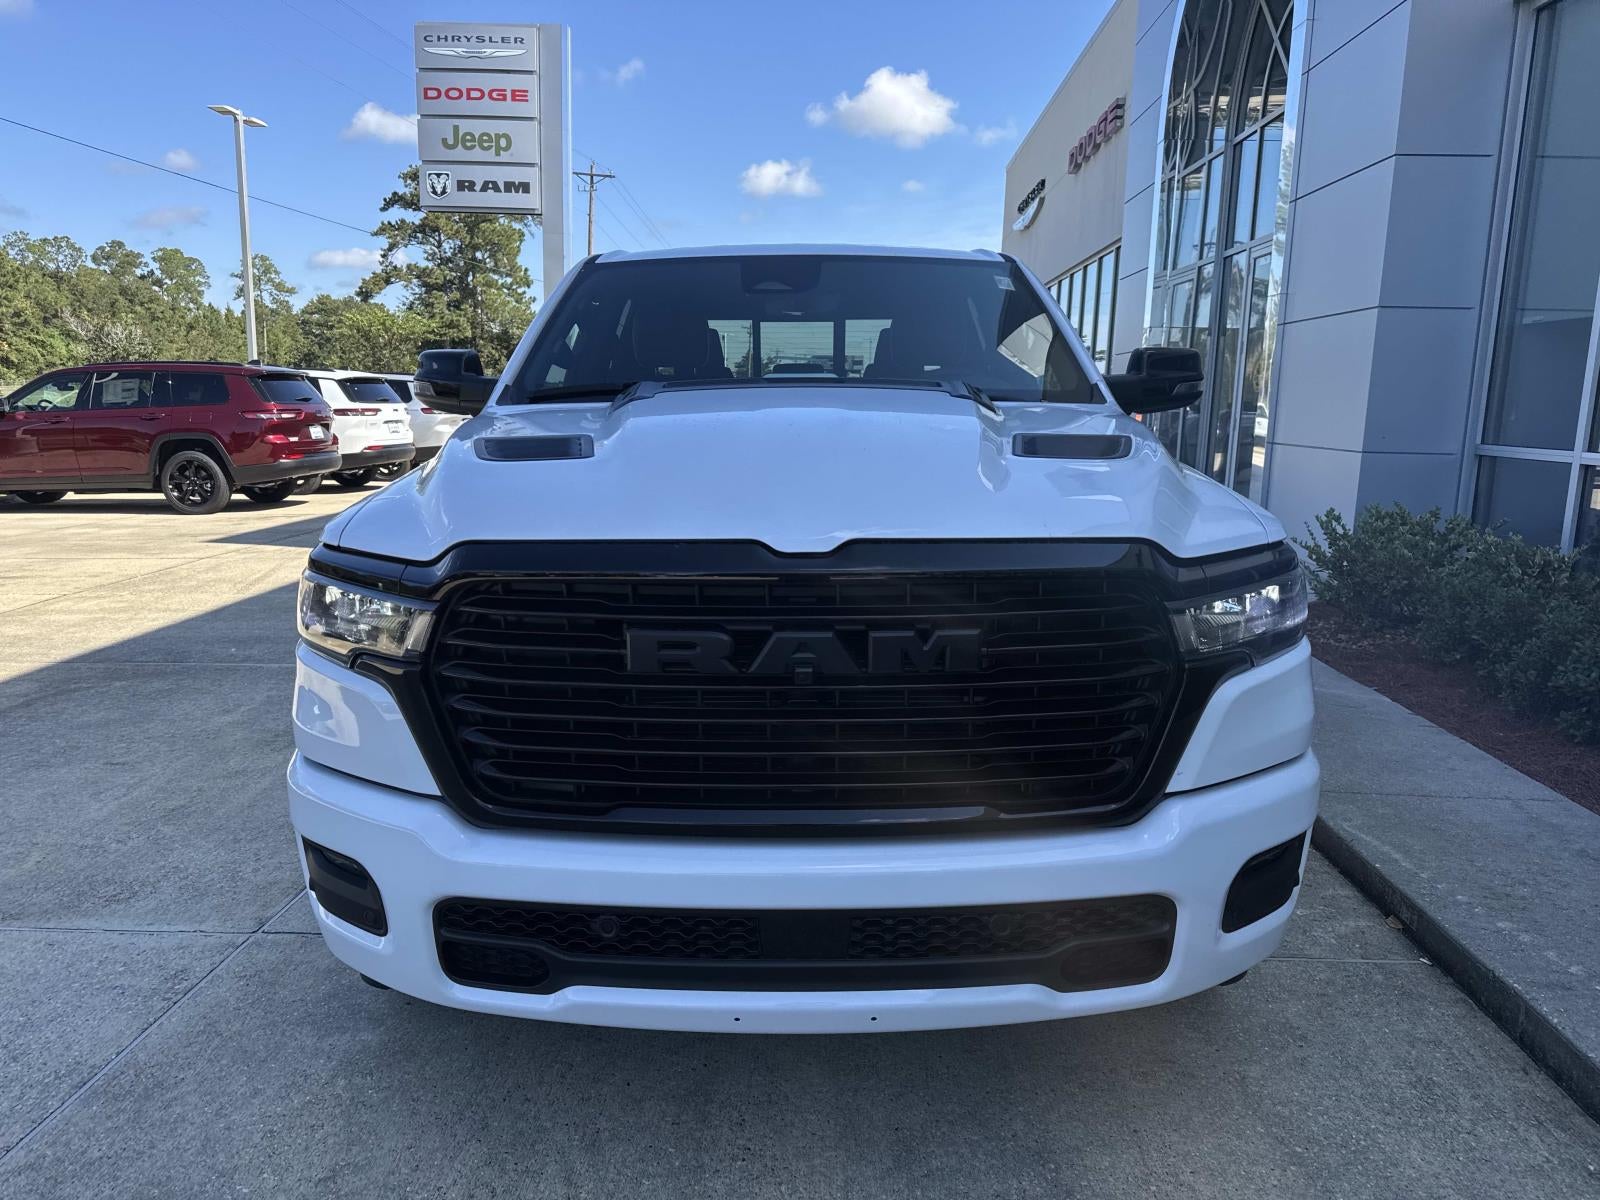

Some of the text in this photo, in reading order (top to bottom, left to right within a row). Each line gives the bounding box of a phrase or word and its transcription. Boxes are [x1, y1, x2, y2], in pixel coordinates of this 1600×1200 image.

[423, 34, 525, 45] CHRYSLER
[423, 87, 529, 103] DODGE
[441, 124, 513, 157] Jeep
[1067, 97, 1126, 175] DODGE
[456, 179, 531, 194] RAM
[626, 627, 982, 675] RAM
